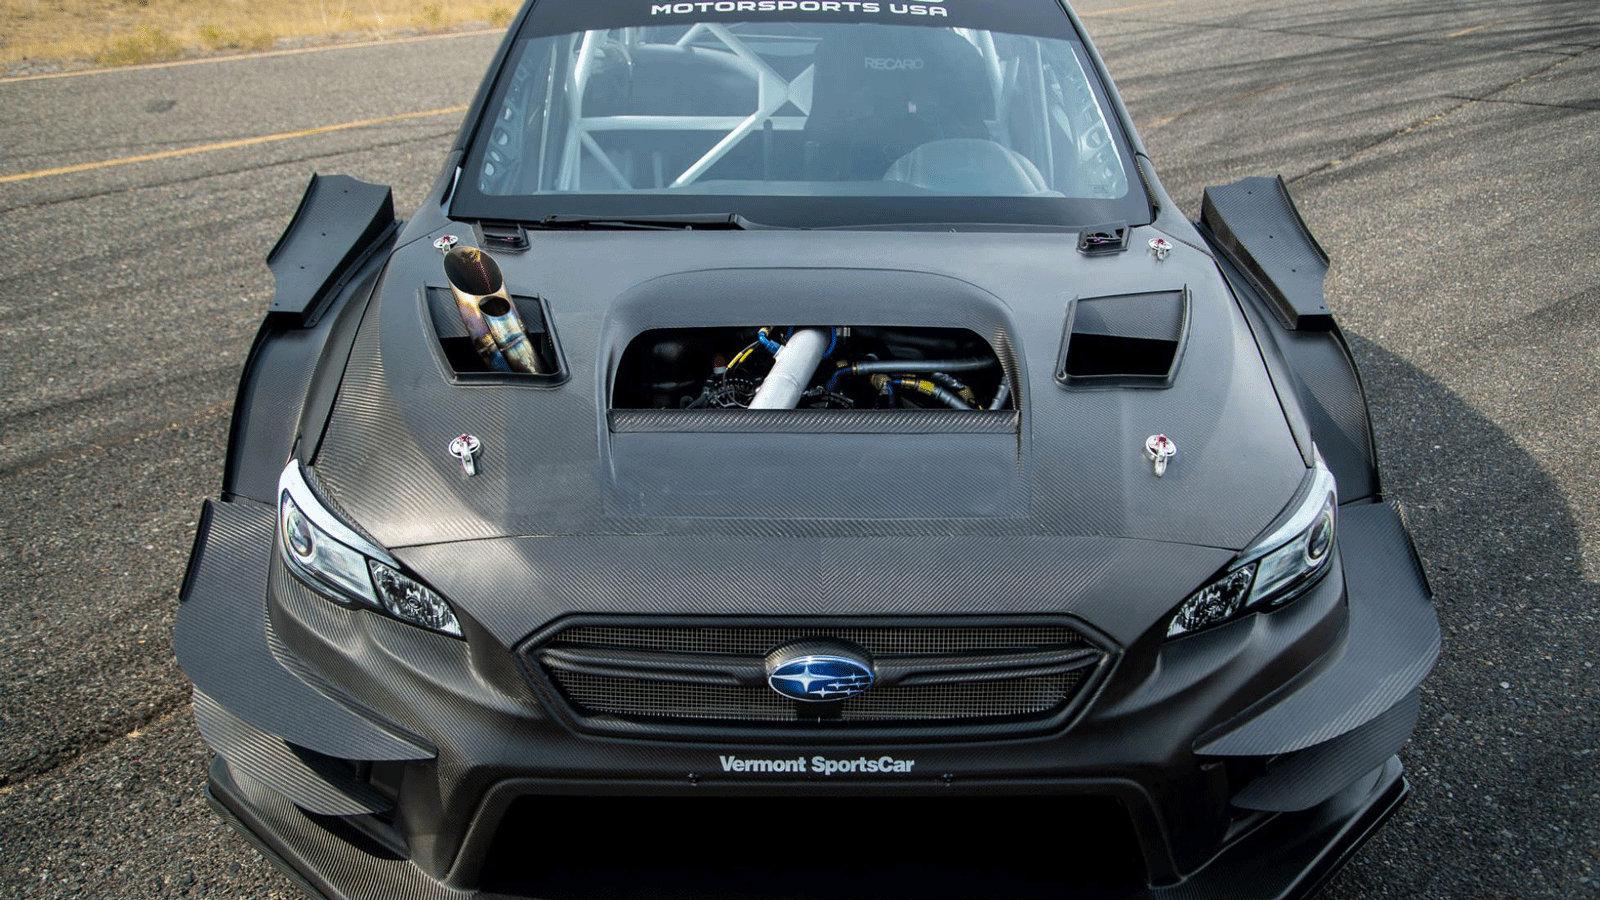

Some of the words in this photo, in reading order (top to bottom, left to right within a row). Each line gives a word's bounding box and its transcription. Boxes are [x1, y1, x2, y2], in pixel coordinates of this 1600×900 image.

[651, 1, 880, 15] MOTORSPORTS
[890, 4, 948, 17] USA
[864, 57, 924, 70] RECARO
[719, 755, 806, 772] Vermont
[811, 756, 915, 775] SportsCar
